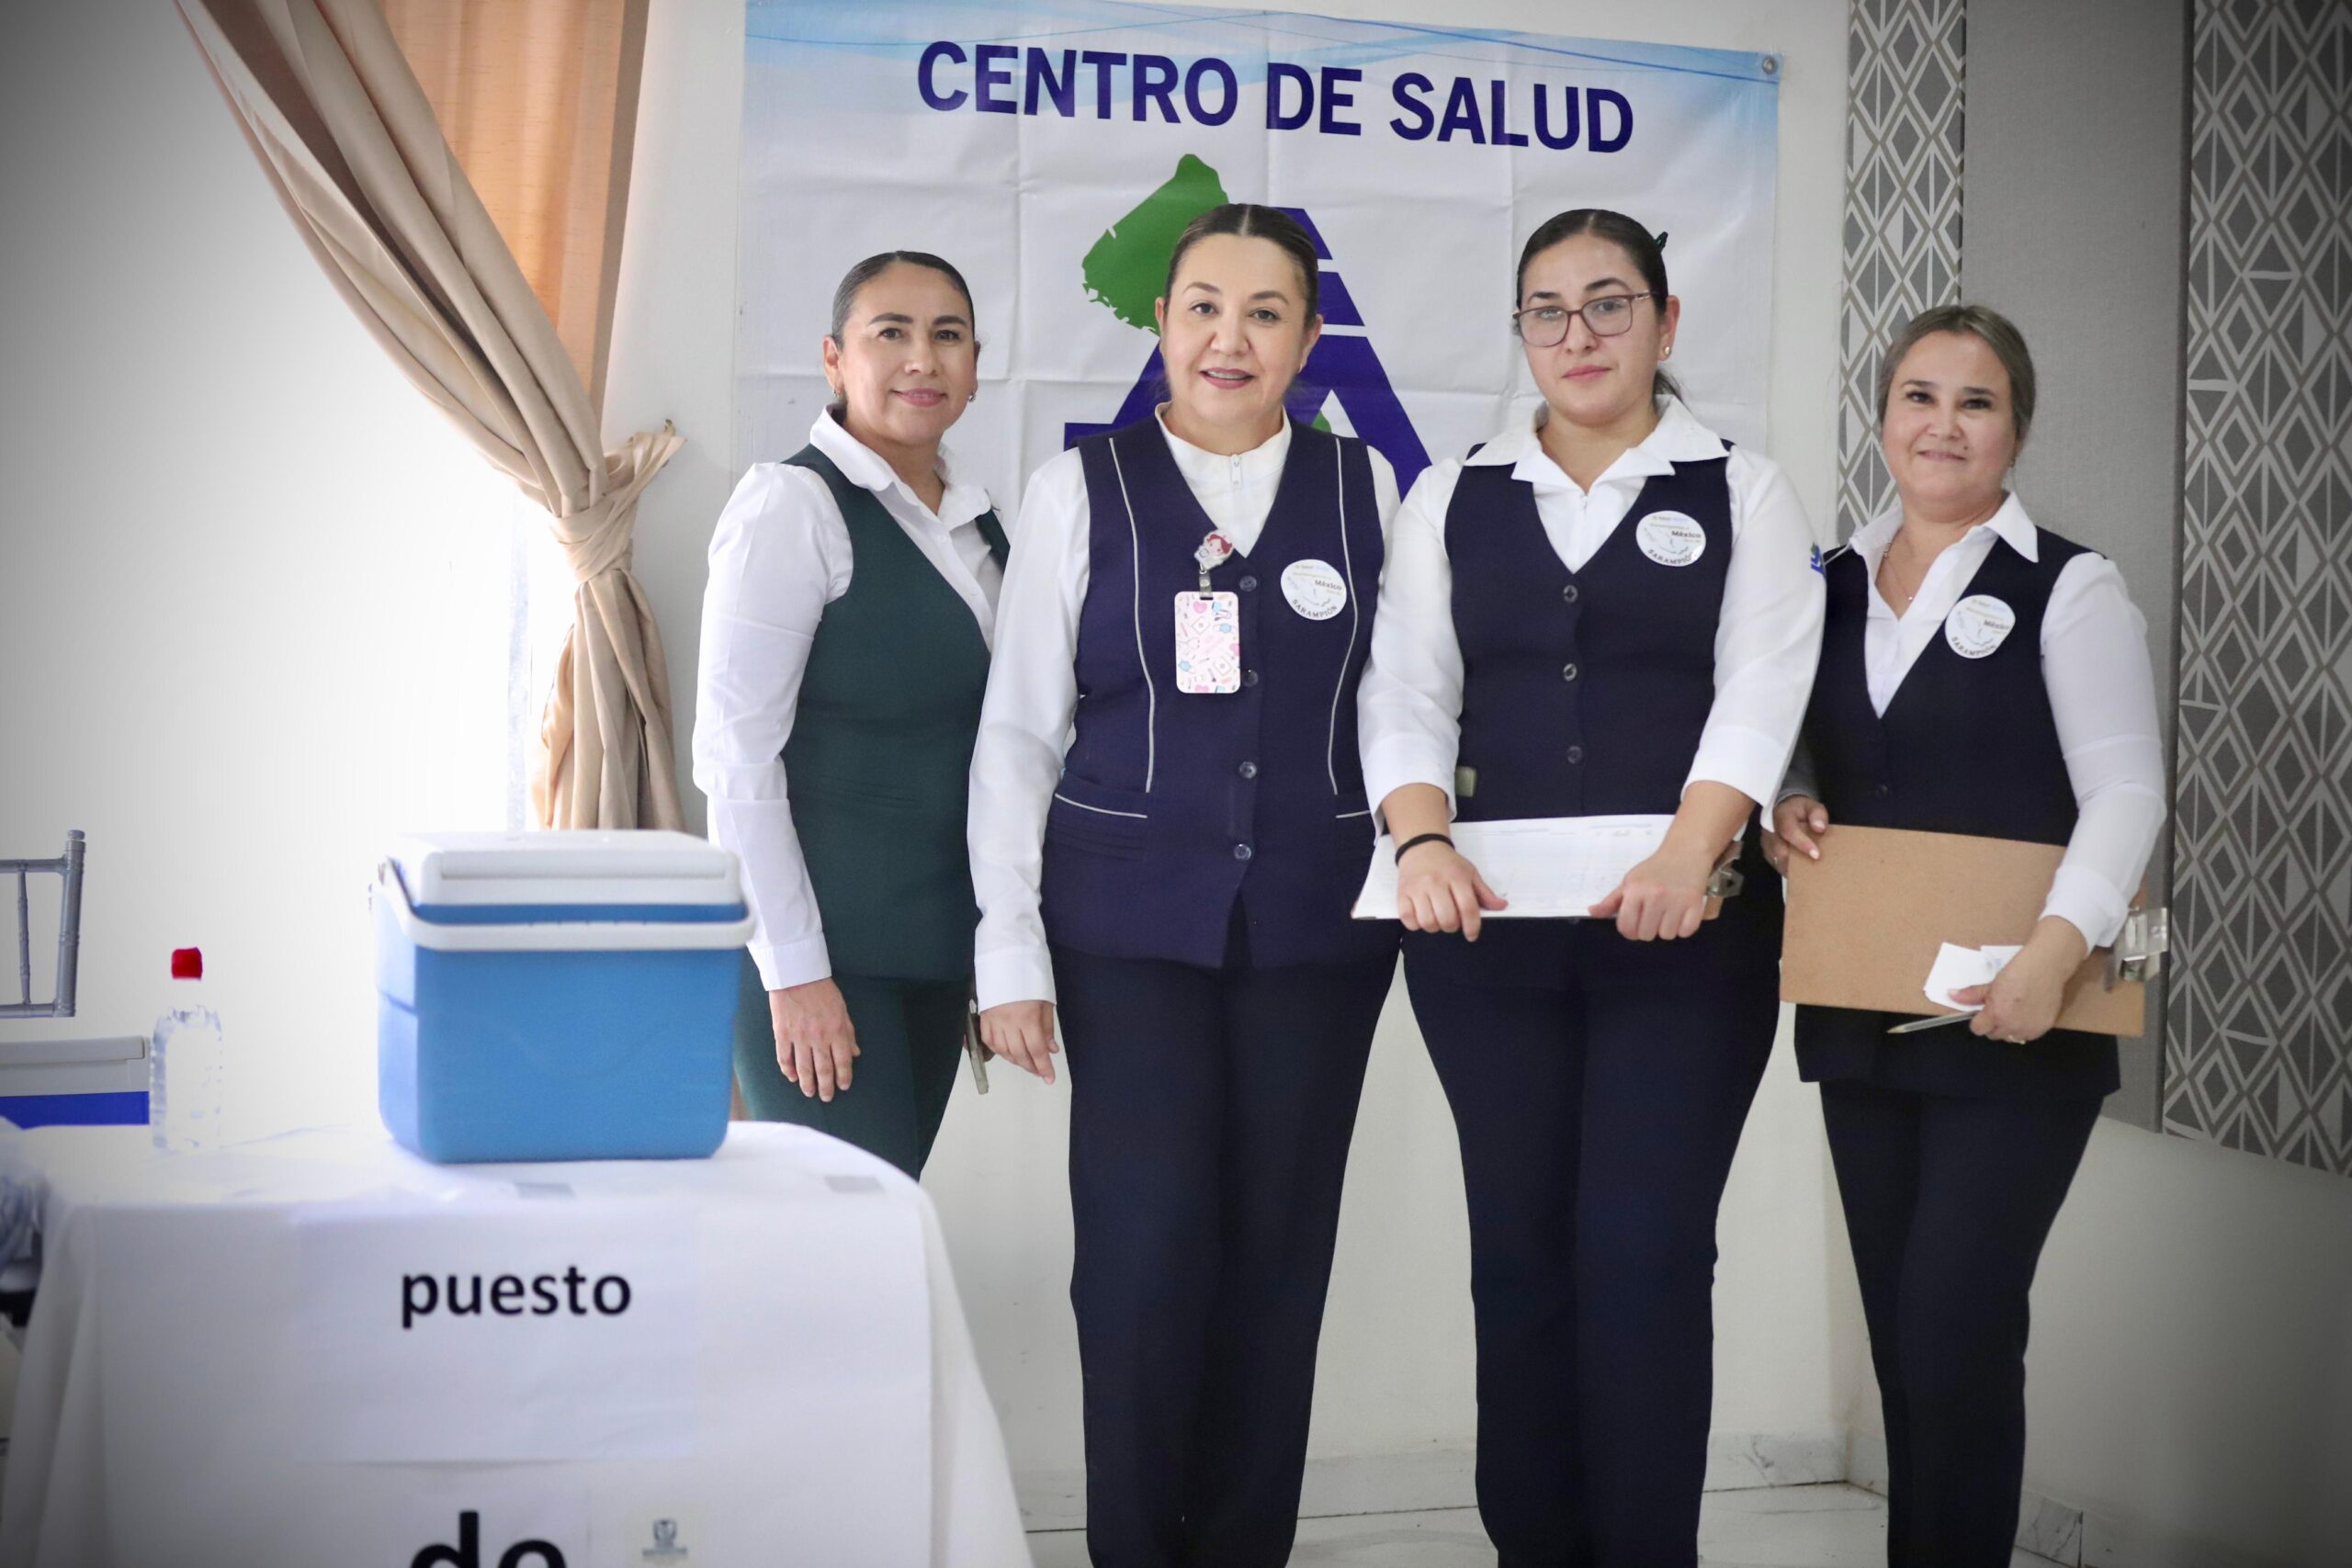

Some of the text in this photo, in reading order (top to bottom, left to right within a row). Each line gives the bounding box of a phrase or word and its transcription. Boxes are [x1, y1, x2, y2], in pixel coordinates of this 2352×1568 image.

[917, 40, 1634, 153] CENTRO DE SALUD
[401, 1265, 632, 1330] puesto
